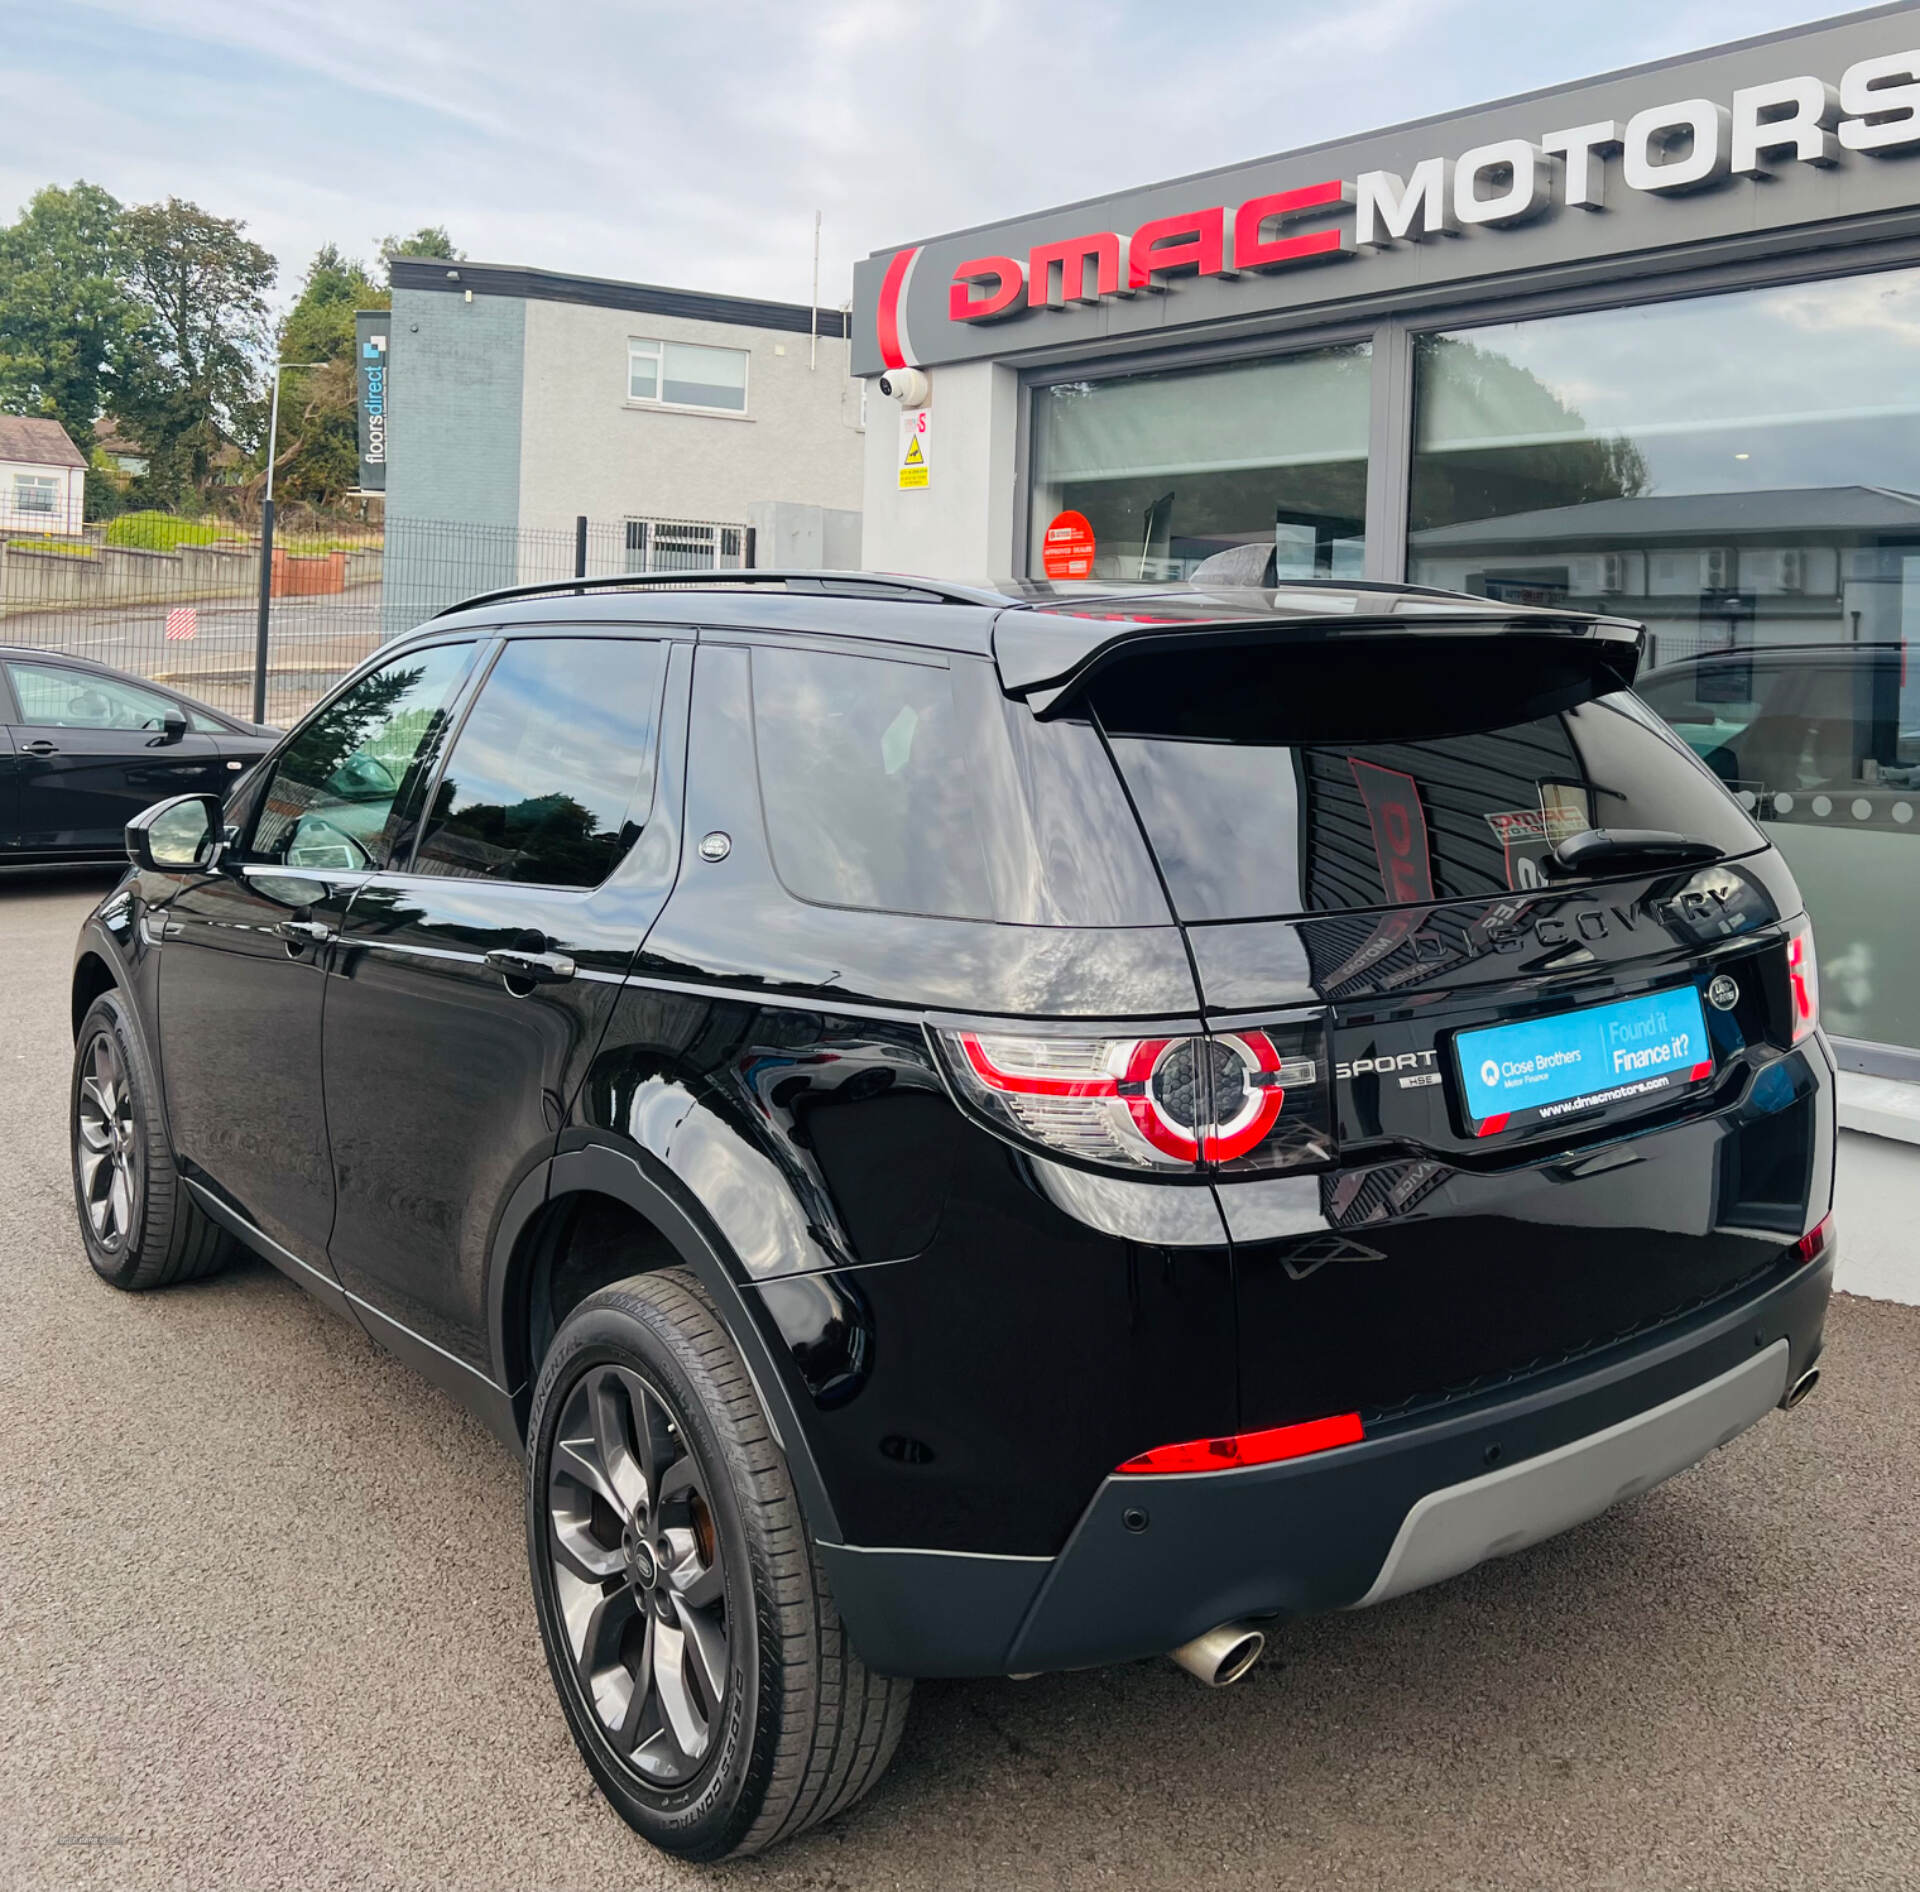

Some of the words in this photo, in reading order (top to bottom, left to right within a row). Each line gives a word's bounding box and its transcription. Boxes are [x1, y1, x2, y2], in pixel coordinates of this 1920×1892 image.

[949, 179, 1343, 322] DMAC
[1356, 49, 1920, 244] MOTORS
[365, 366, 384, 464] floorsdirect
[1407, 885, 1729, 963] DISCOVERY
[1608, 1016, 1657, 1045] Found
[1657, 1011, 1669, 1034] it
[1335, 1049, 1438, 1080] SPORT
[1501, 1057, 1535, 1078] Close
[1535, 1050, 1582, 1070] Brothers
[1612, 1042, 1670, 1074] Finance
[1671, 1033, 1689, 1057] it?
[1409, 1075, 1433, 1086] HSE
[1504, 1077, 1523, 1089] Motor
[1524, 1072, 1549, 1084] Finance
[1539, 1076, 1670, 1119] www.dmacmotors.com
